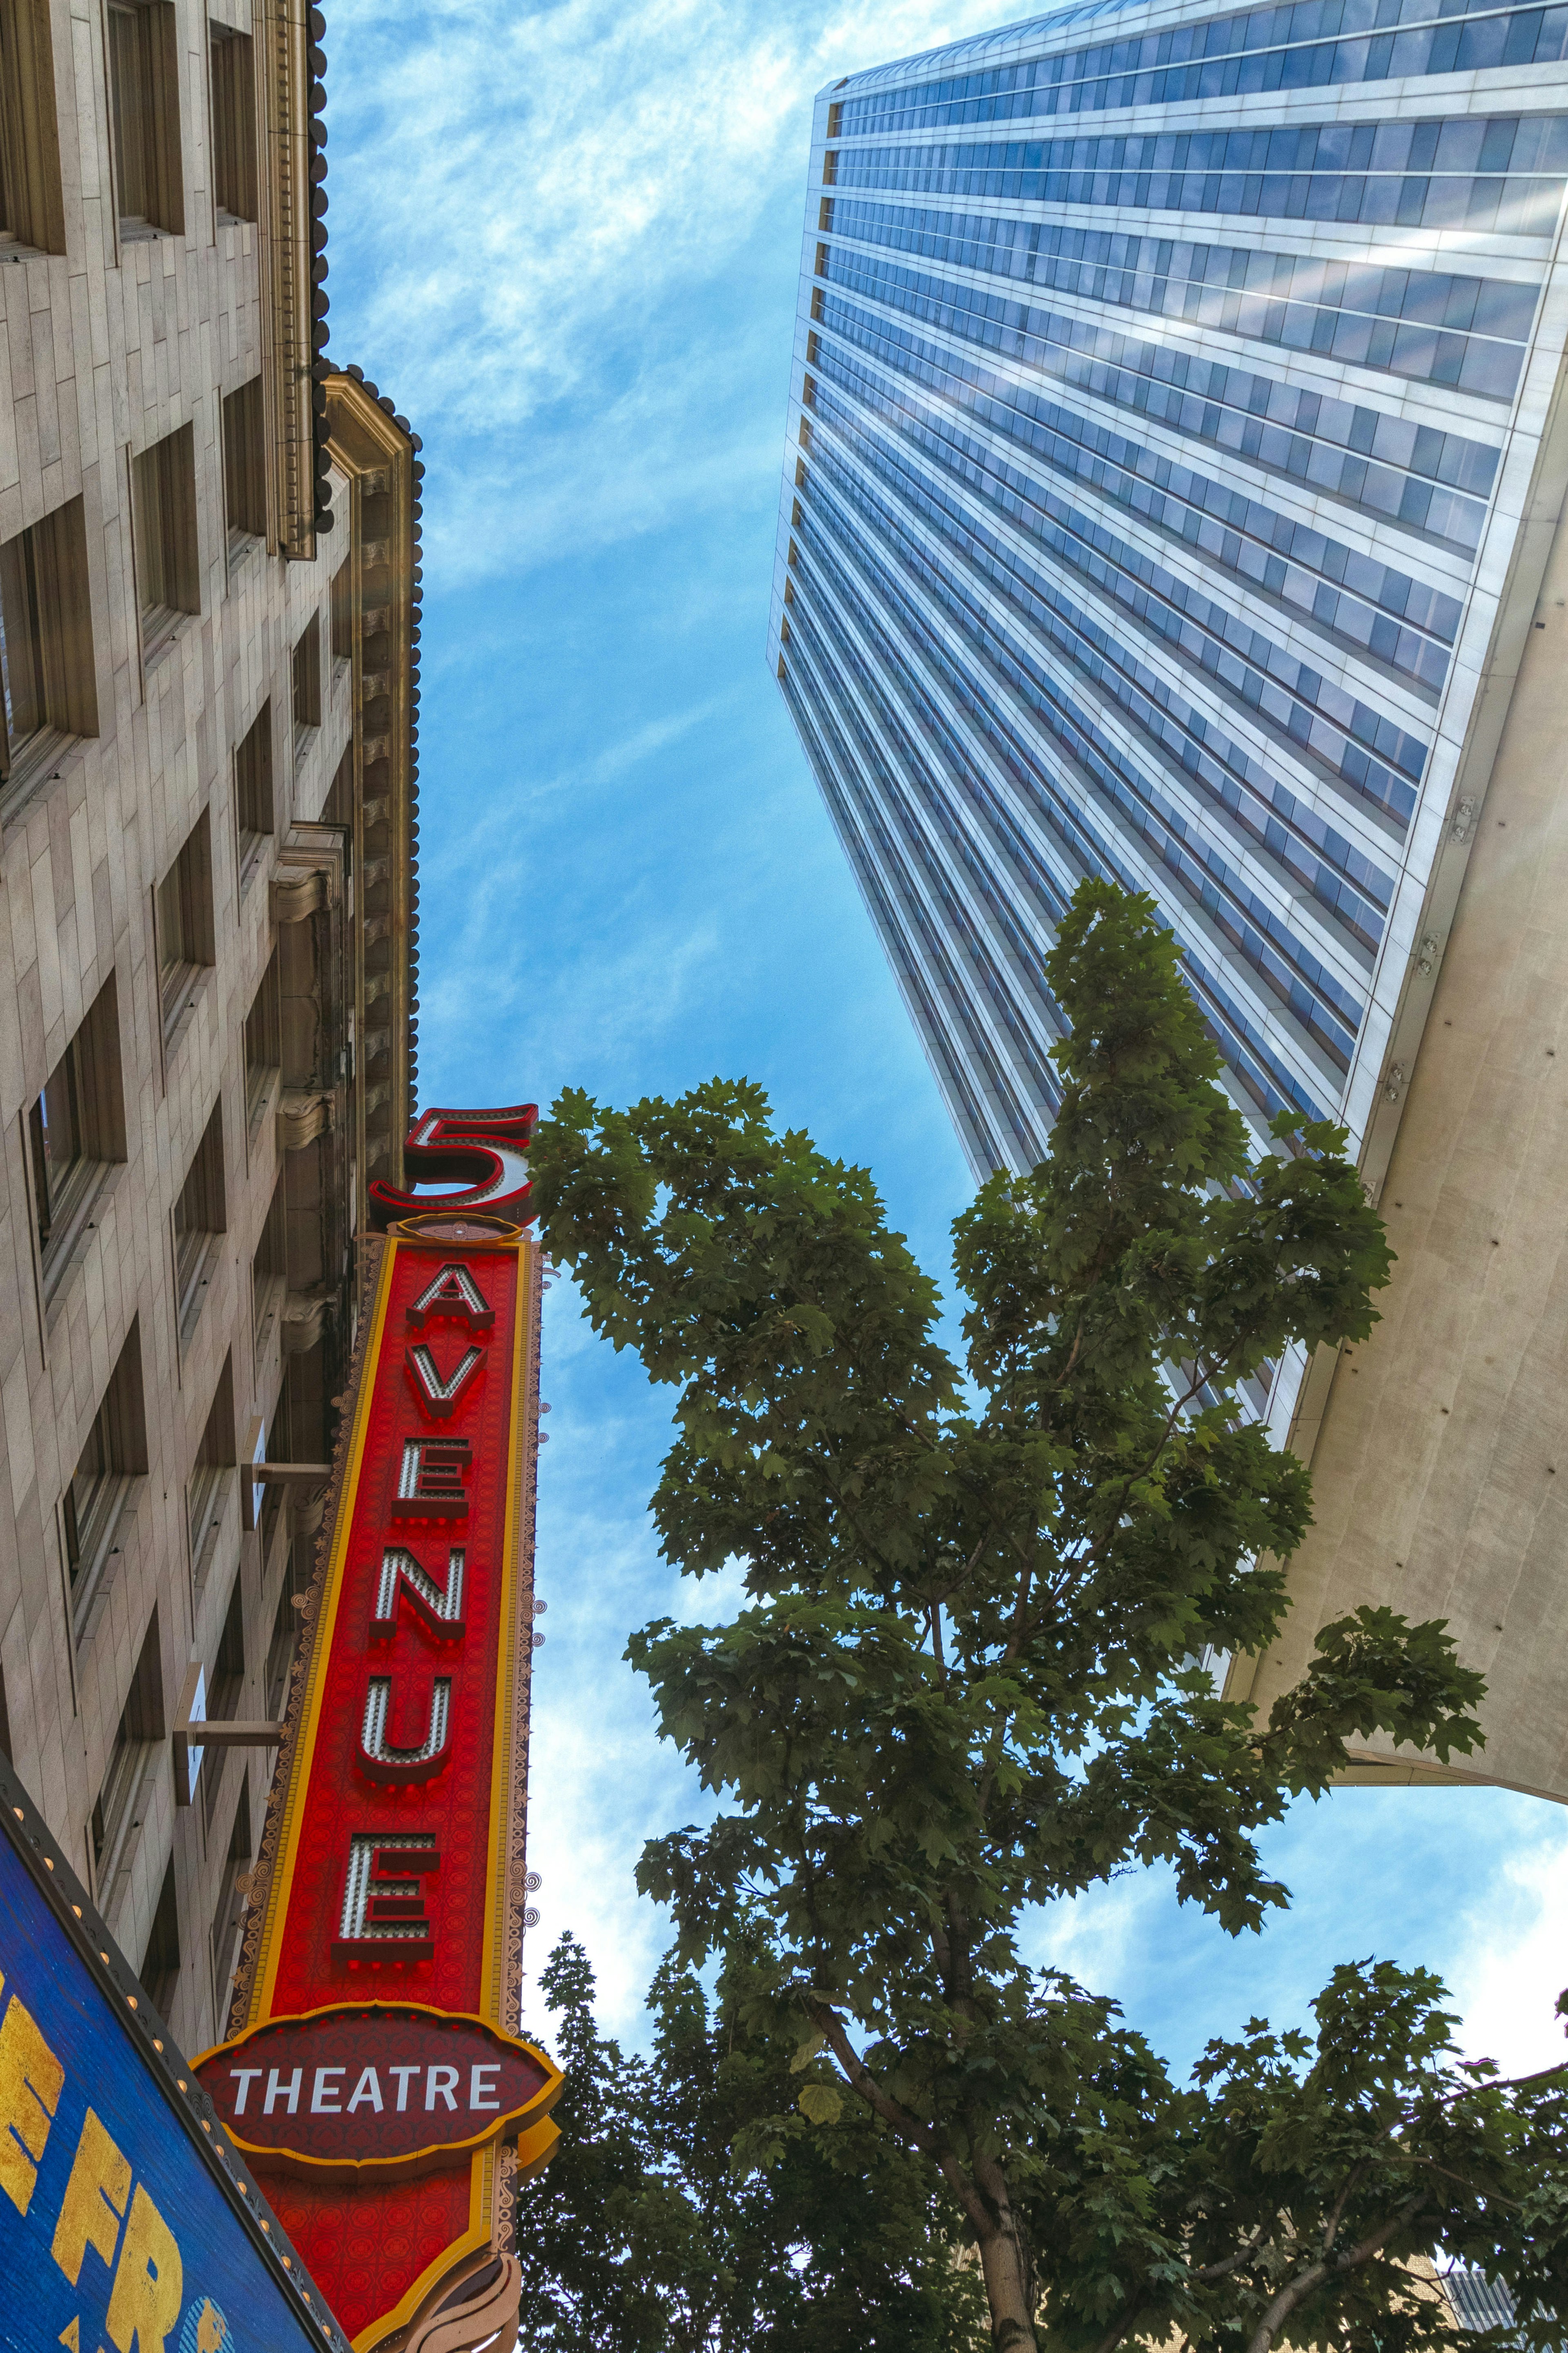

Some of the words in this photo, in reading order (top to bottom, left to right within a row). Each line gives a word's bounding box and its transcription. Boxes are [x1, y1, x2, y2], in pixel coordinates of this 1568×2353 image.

[369, 1104, 538, 1221] 5
[332, 1262, 494, 1960] AVENUE
[229, 2064, 501, 2115] THEATRE
